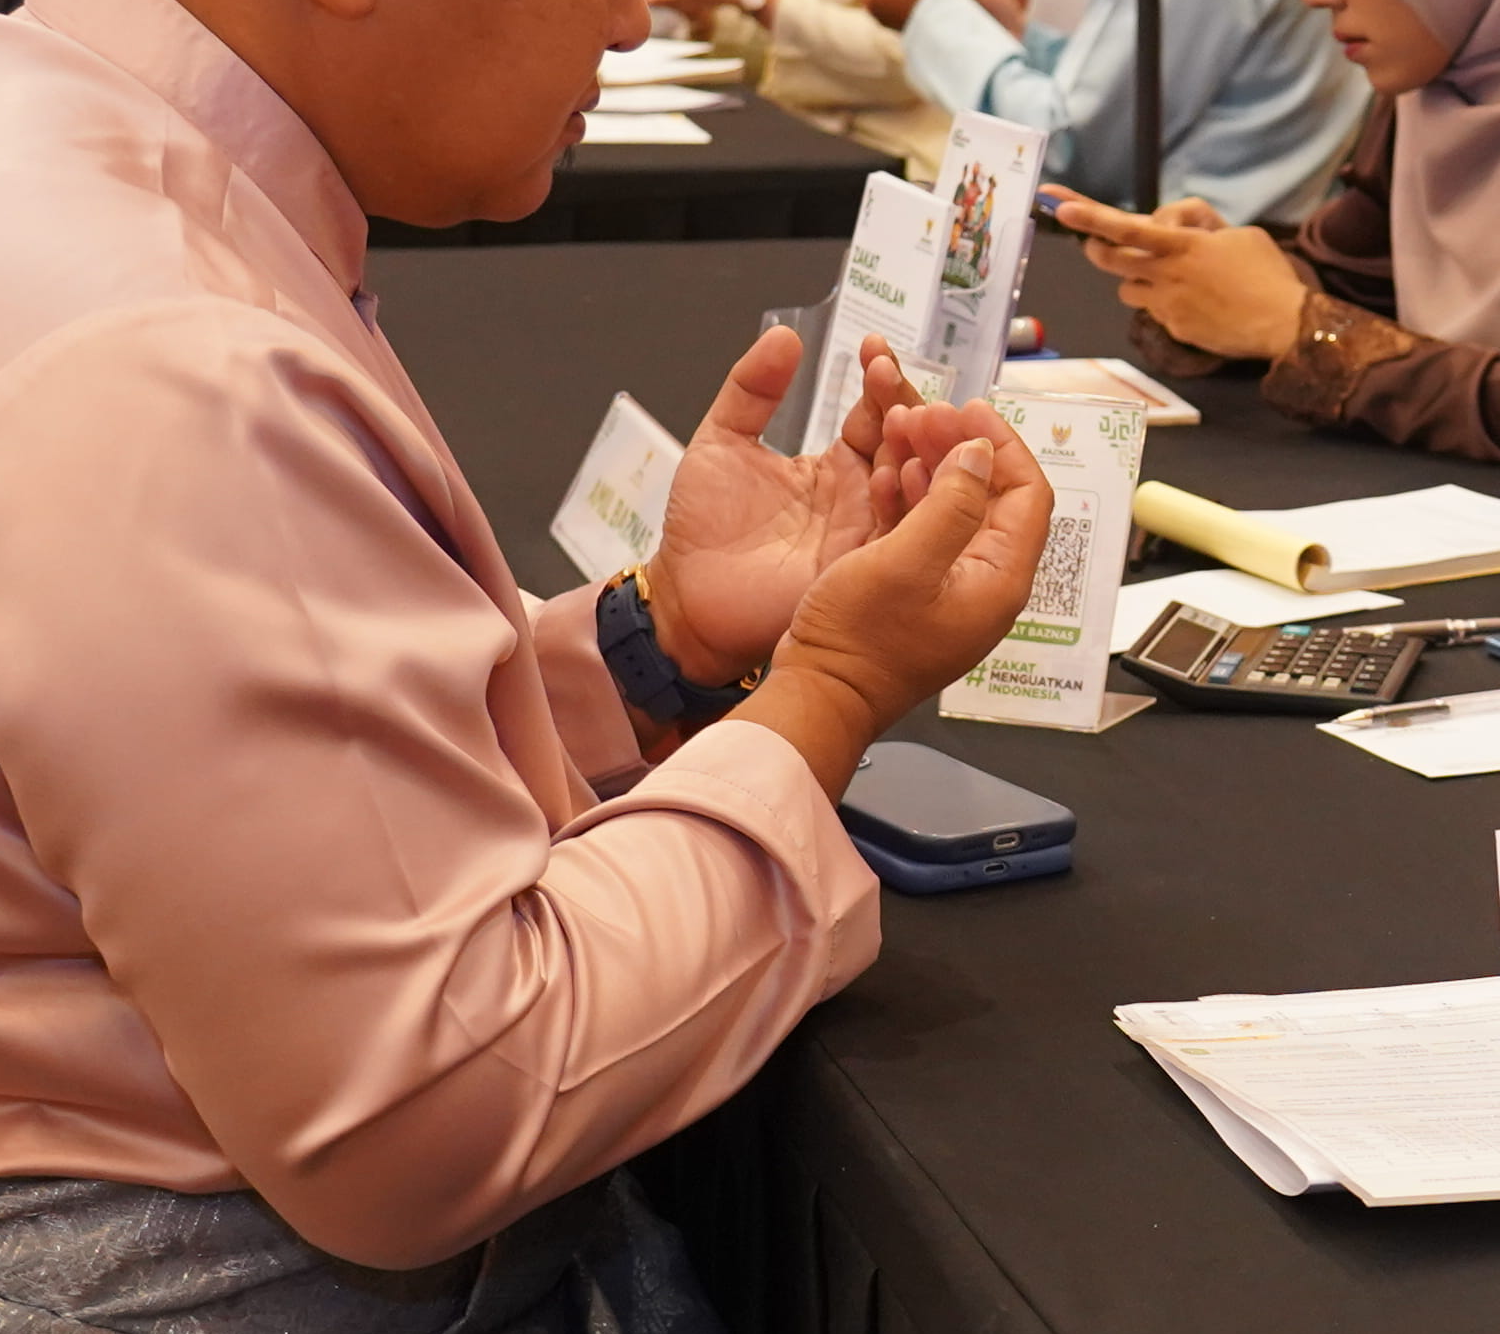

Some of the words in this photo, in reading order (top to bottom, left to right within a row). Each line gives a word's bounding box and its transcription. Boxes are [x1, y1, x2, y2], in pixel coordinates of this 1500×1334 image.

[847, 267, 906, 308] PENGHASILAN
[1028, 626, 1074, 641] BAZNAS
[992, 658, 1036, 673] ZAKAT
[990, 670, 1083, 691] MENGUATKAN
[988, 682, 1061, 701] INDONESIA
